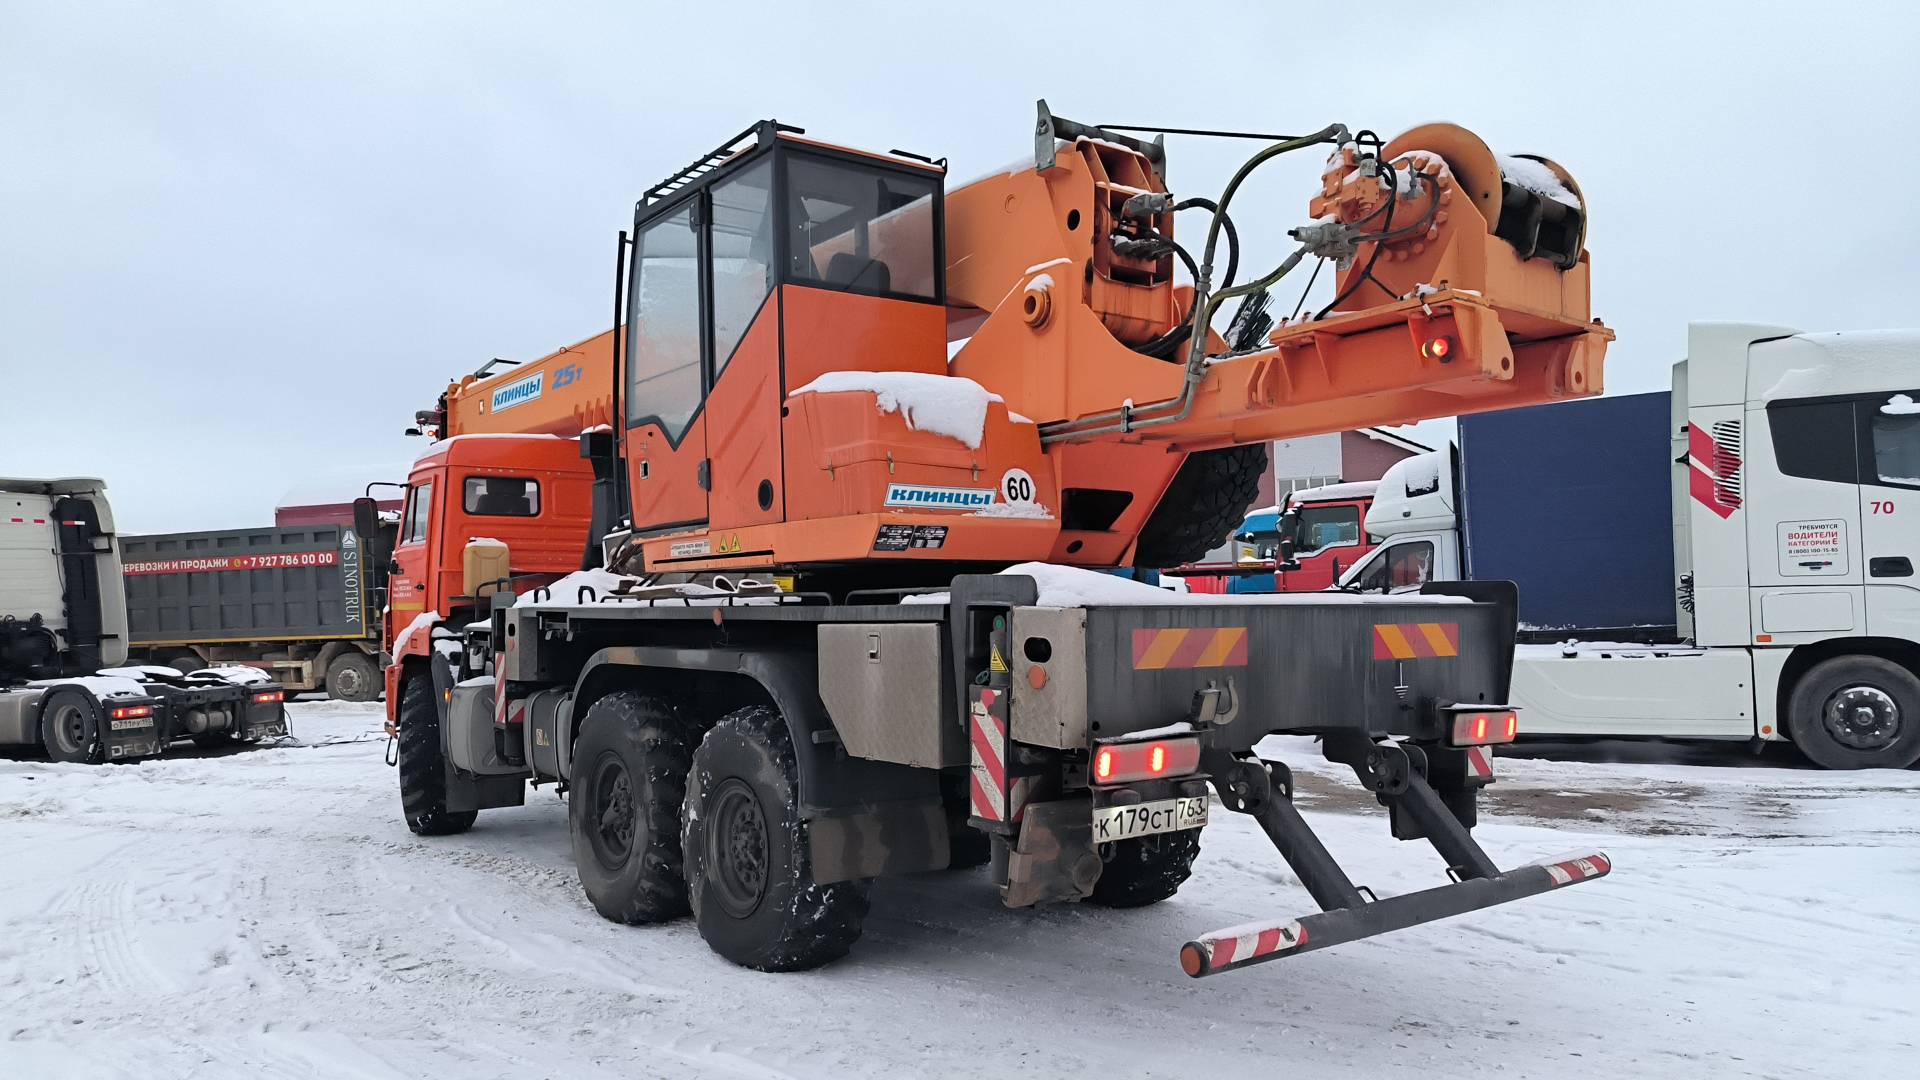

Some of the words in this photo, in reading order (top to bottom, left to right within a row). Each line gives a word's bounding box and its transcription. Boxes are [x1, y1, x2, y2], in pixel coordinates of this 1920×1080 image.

[493, 378, 541, 406] КЛИНЦЫ
[891, 489, 991, 506] КЛИНЦЫ
[1007, 477, 1030, 501] 60
[1870, 501, 1895, 514] 70
[1788, 531, 1838, 540] ВОДИТЕЛИ
[172, 560, 179, 570] И
[180, 558, 229, 570] ПРОДАЖИ
[259, 556, 278, 567] 927
[279, 555, 299, 565] 786
[301, 554, 317, 565] 00
[318, 553, 333, 564] 00
[343, 551, 360, 623] SINOTRUK
[1100, 807, 1174, 838] К179СТ
[1178, 798, 1204, 819] 763
